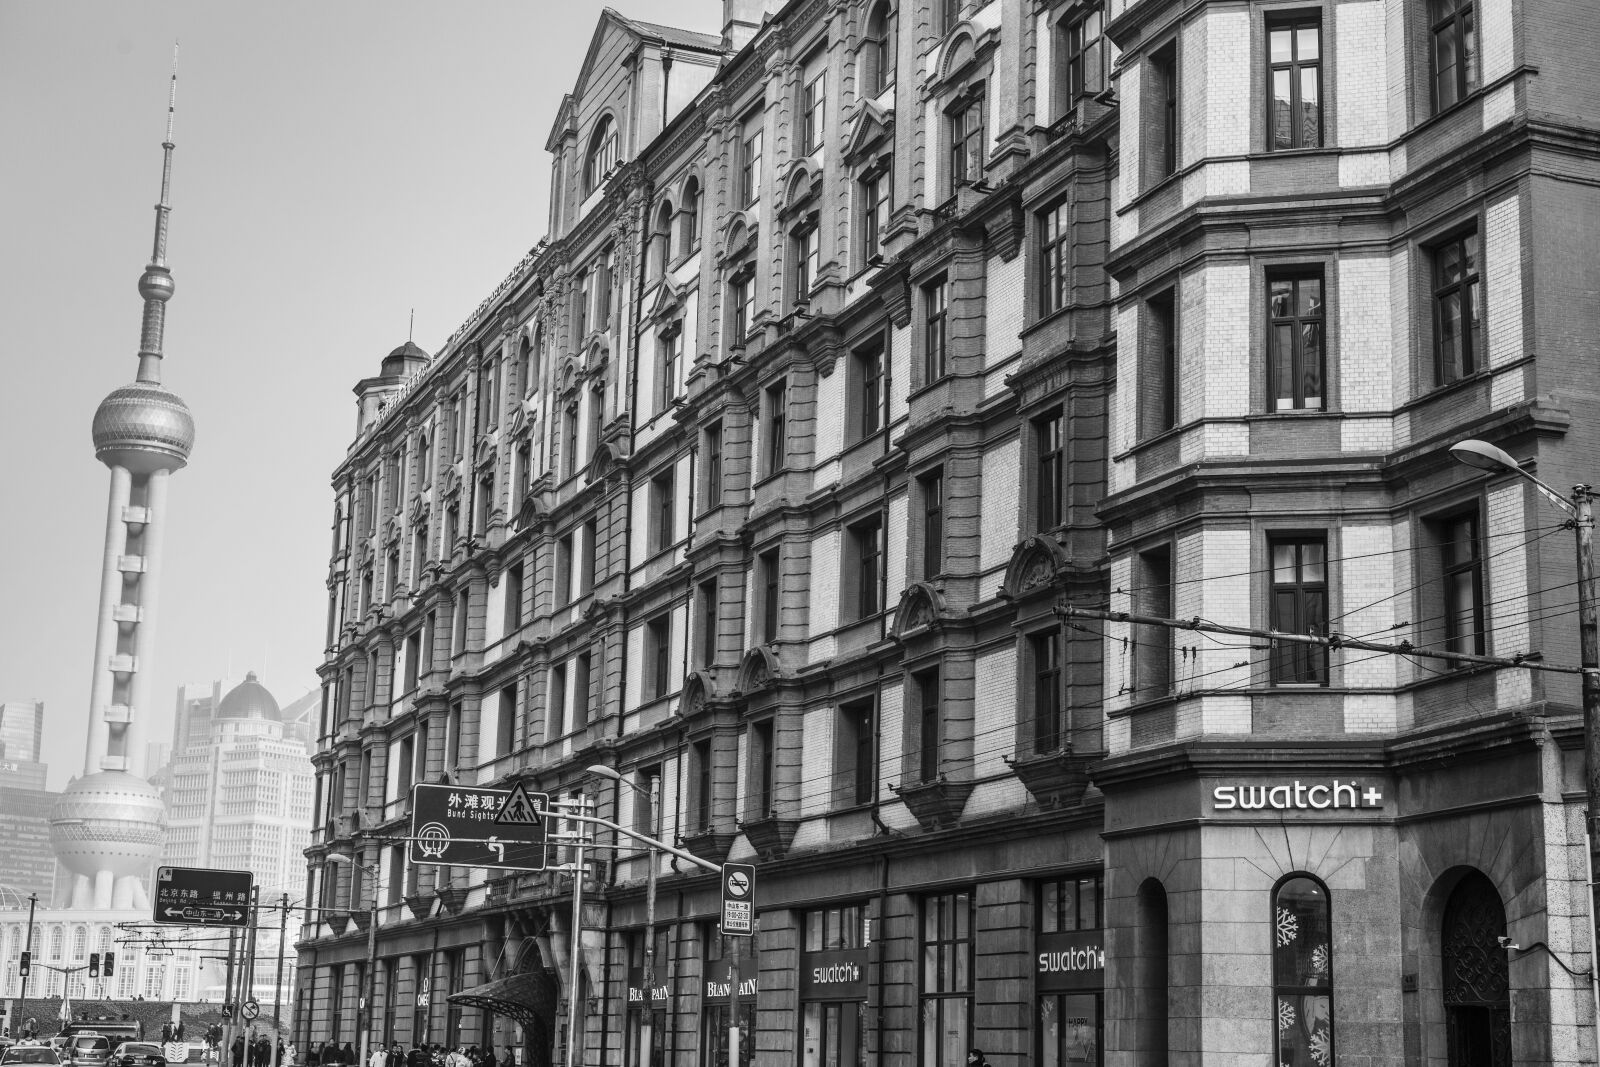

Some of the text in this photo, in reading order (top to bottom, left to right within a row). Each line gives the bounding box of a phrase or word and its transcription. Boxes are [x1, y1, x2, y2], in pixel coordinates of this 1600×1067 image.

[447, 808, 466, 818] Bund
[160, 888, 199, 899] 北京东路
